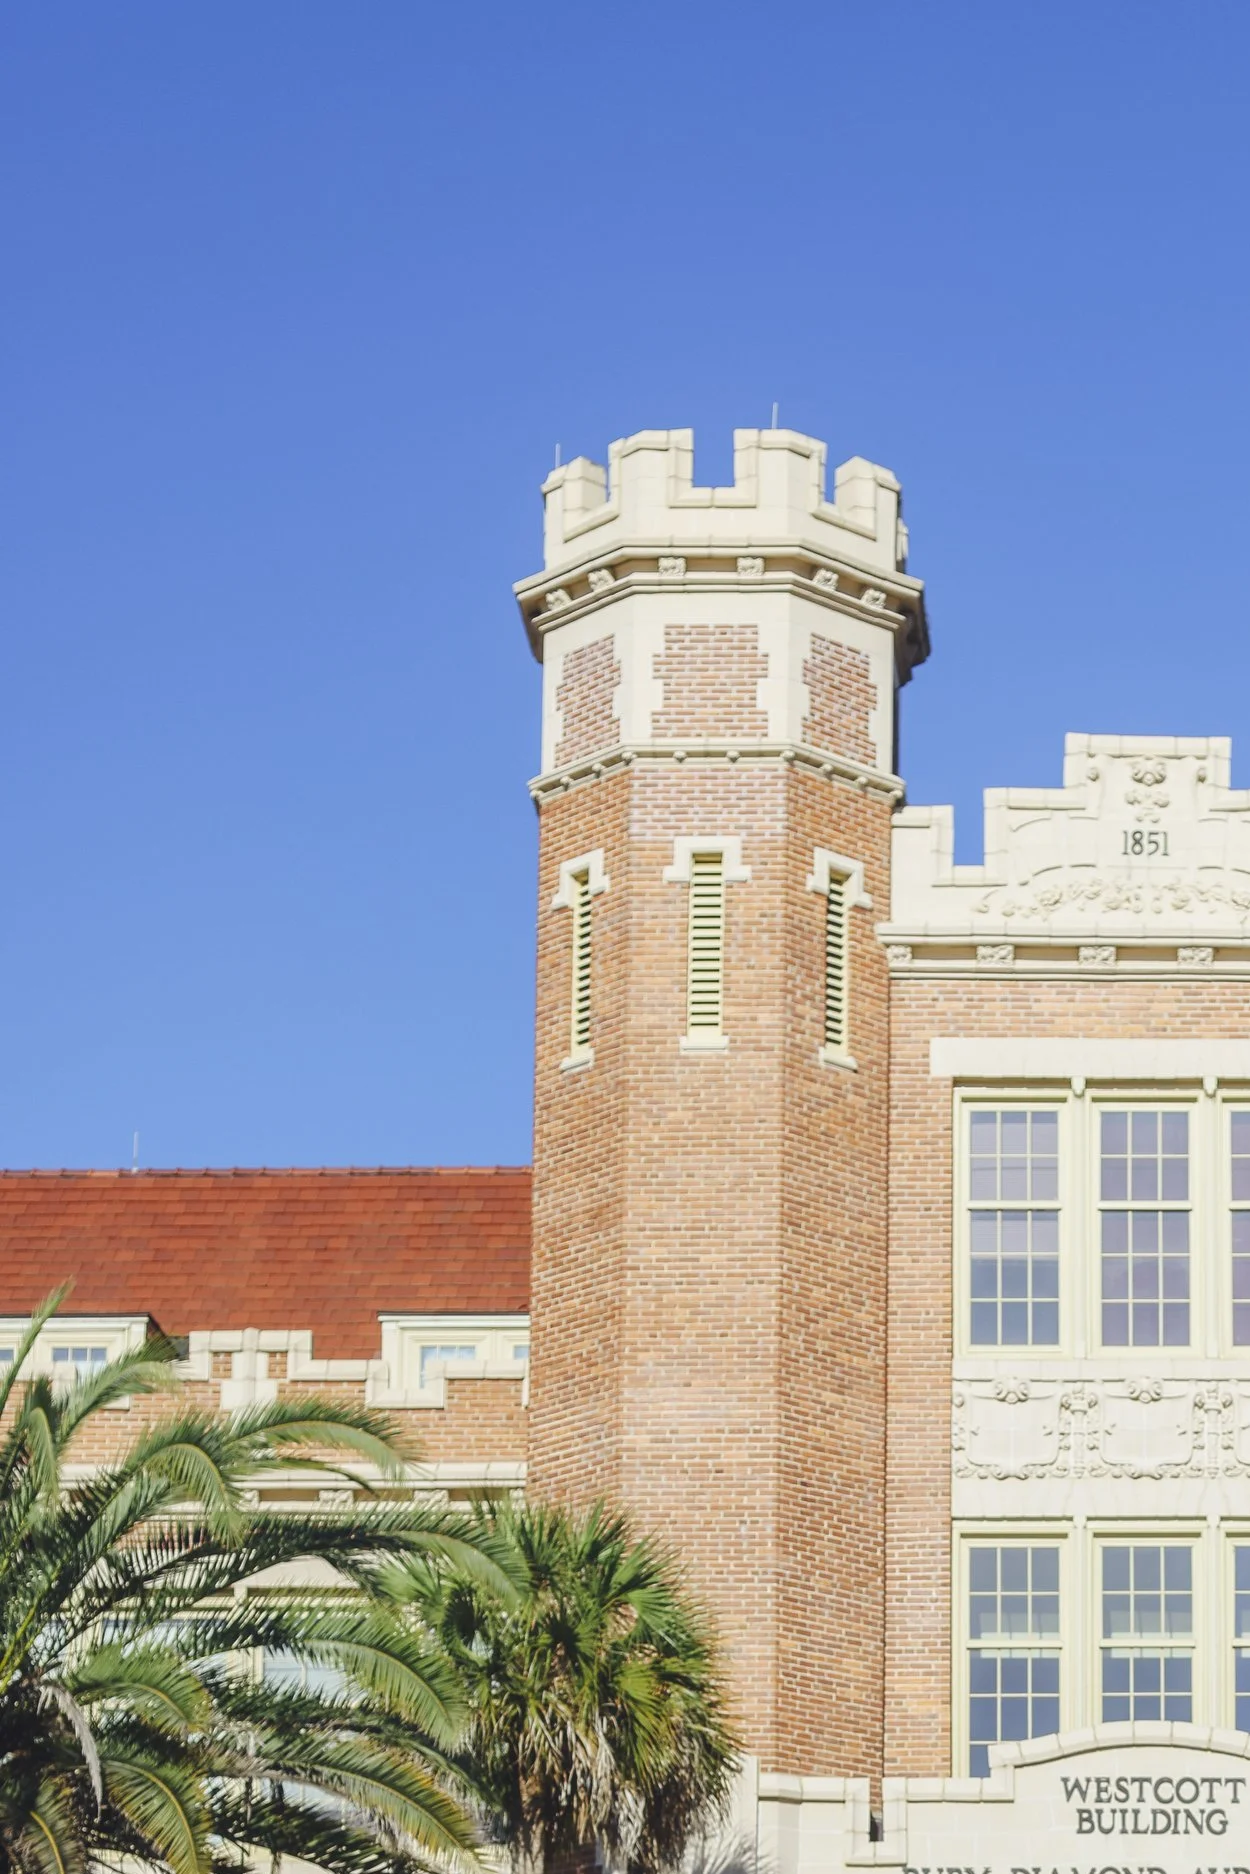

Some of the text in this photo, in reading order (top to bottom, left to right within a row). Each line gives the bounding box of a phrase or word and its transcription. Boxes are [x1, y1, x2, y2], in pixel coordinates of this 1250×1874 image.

[1121, 830, 1170, 856] 1851
[1060, 1776, 1247, 1805] WESTCOTT
[1076, 1808, 1229, 1836] BUILDING
